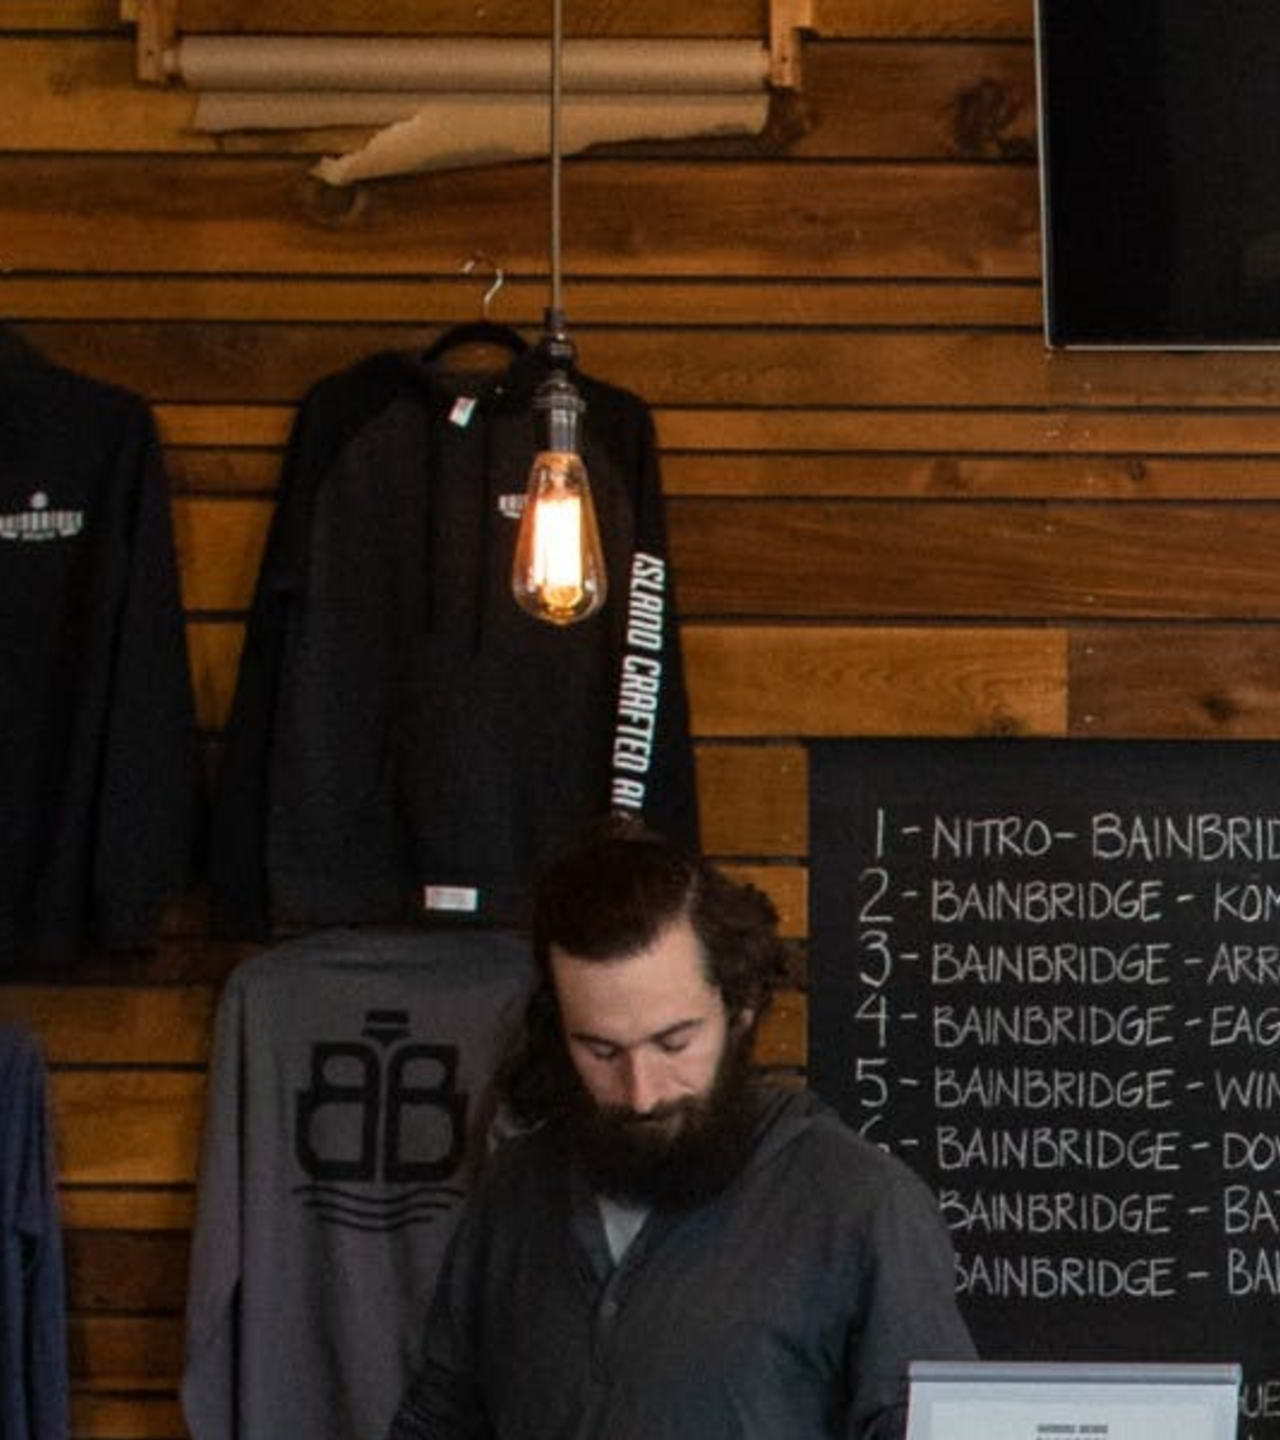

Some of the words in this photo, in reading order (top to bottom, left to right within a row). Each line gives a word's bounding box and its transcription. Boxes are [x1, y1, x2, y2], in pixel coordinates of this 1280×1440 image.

[626, 553, 665, 651] ISLAND
[612, 655, 662, 773] CRAFTED
[931, 879, 1163, 923] BAINBRIDGE
[931, 942, 1171, 986] BAINBRIDGE
[933, 1004, 1174, 1048] BAINBRIDGE
[934, 1066, 1175, 1110] BAINBRIDGE
[936, 1126, 1181, 1171] BAINBRIDGE
[938, 1190, 1174, 1234] BAINBRIDGE
